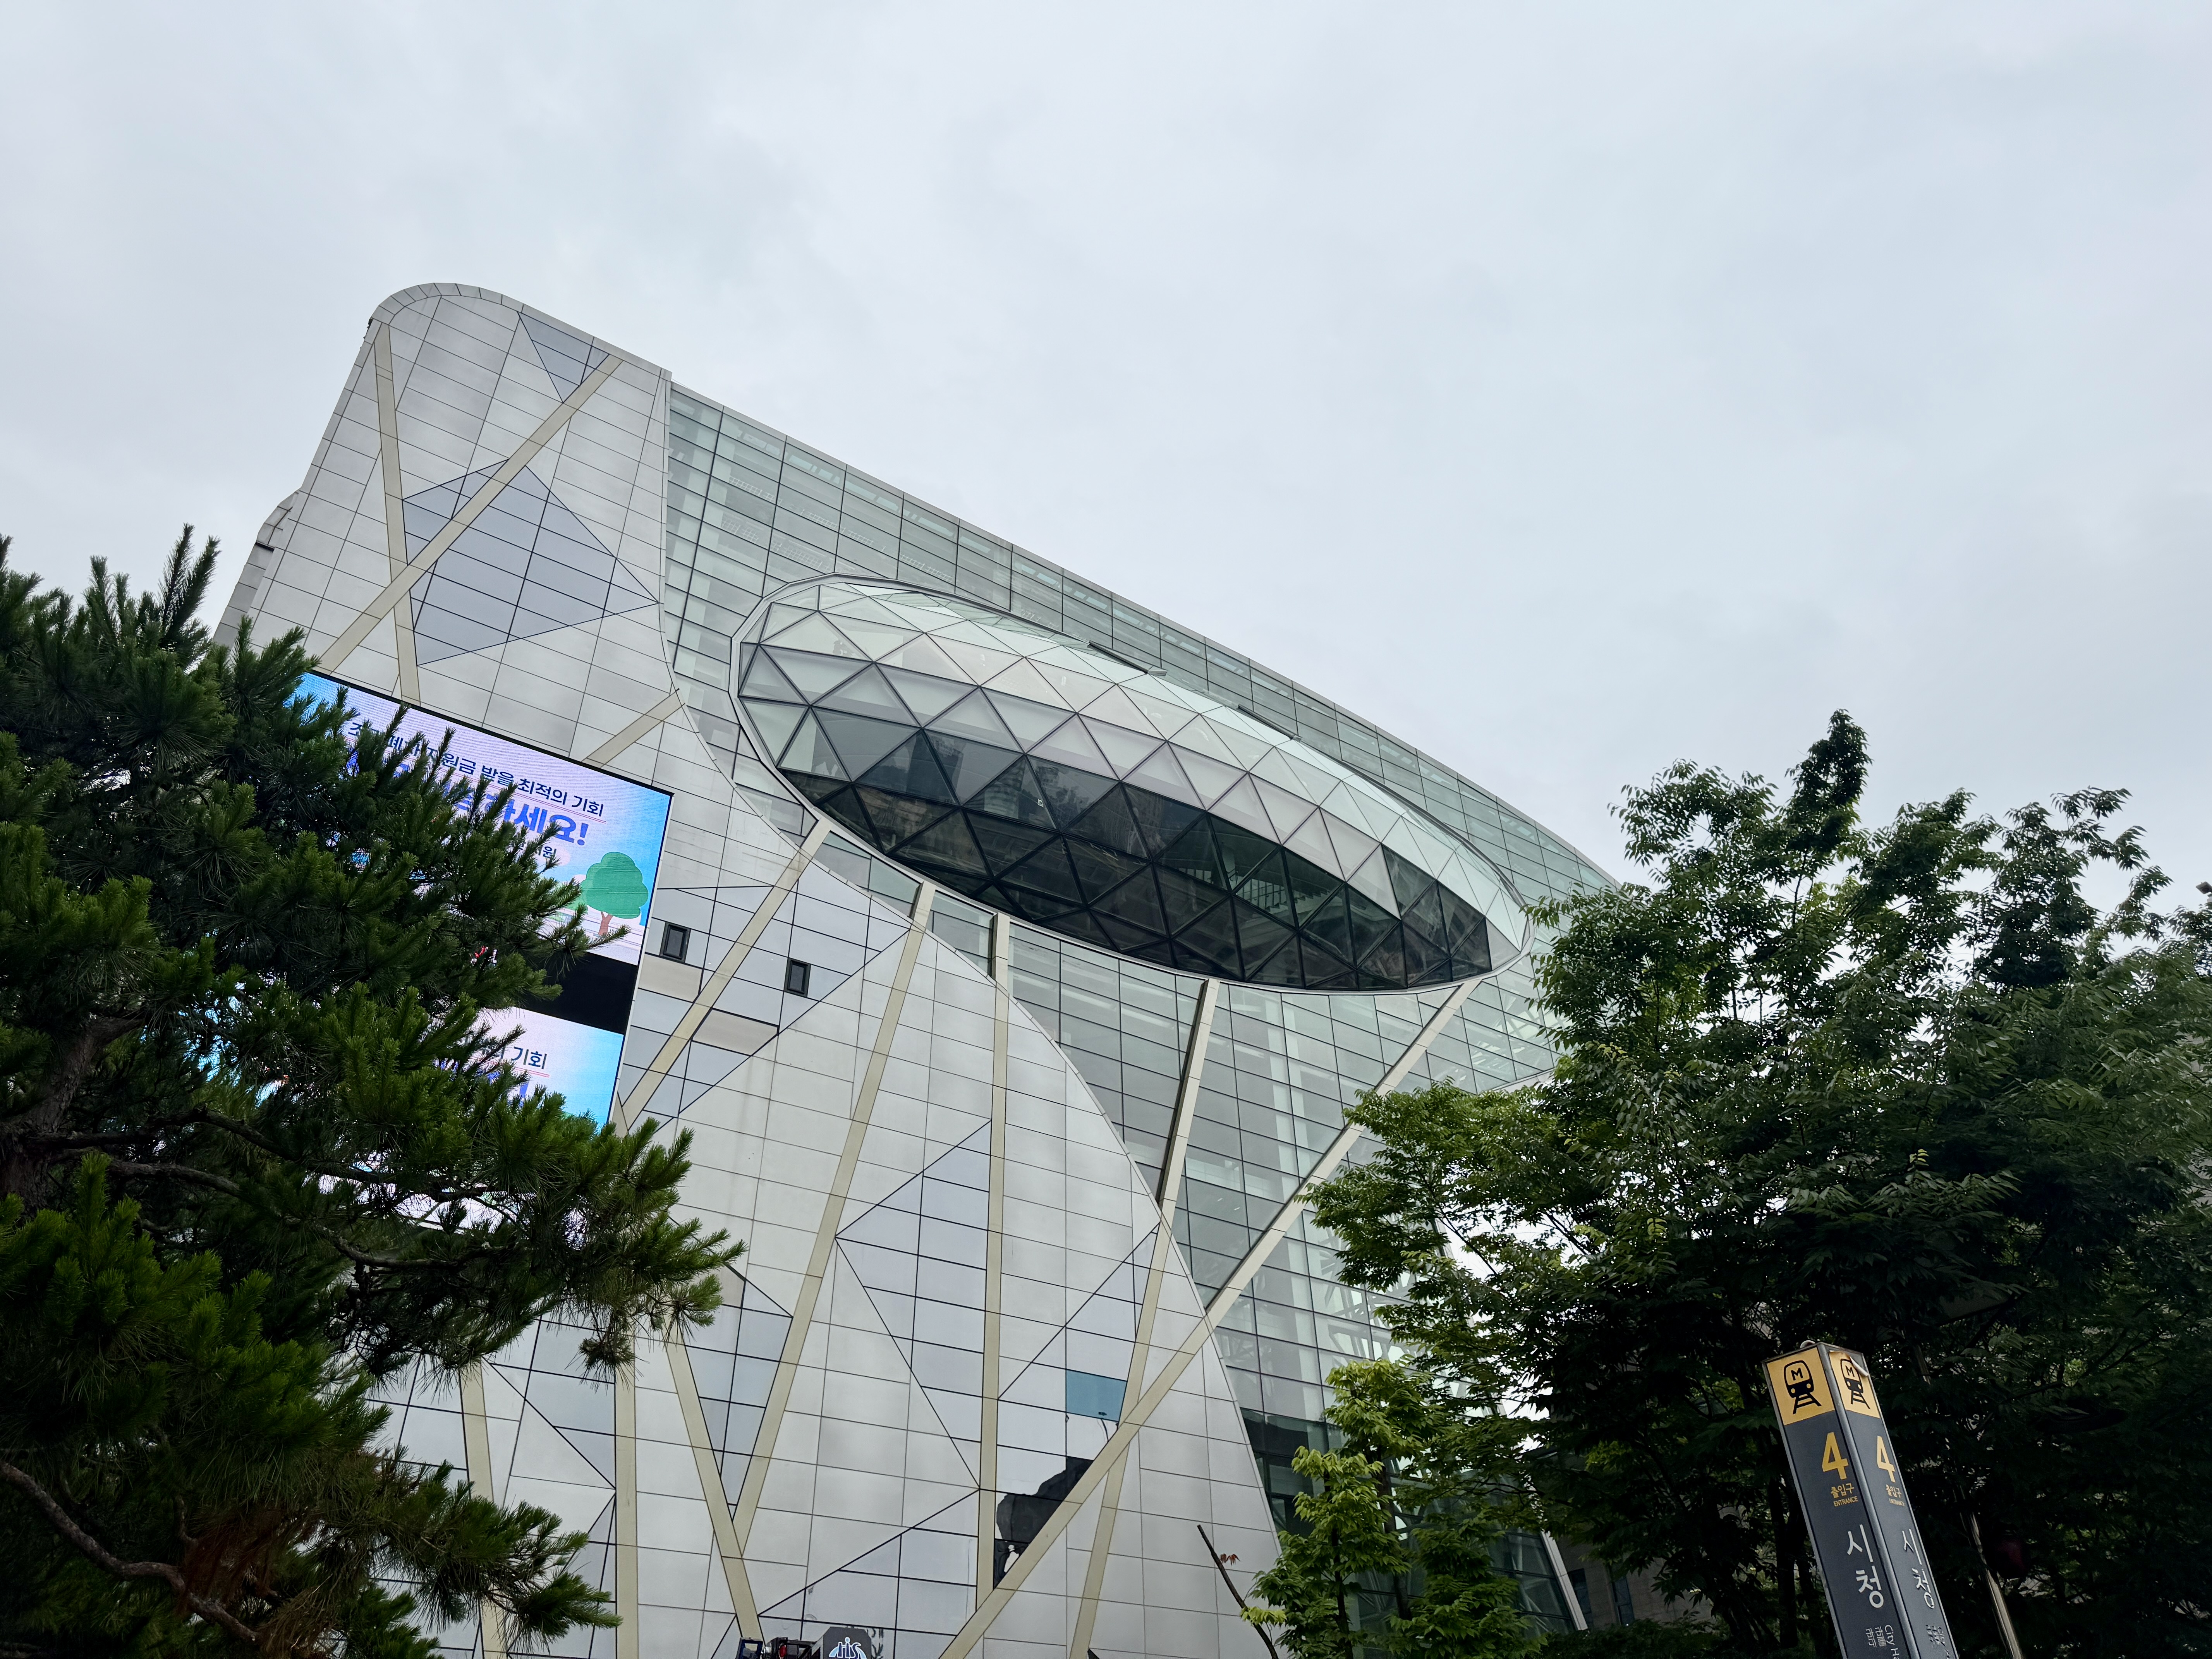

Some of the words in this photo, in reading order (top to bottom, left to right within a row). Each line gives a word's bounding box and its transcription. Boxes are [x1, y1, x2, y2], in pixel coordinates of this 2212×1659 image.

[518, 778, 567, 805] 최적의
[572, 795, 604, 817] 기회
[511, 1046, 547, 1069] 기회
[1791, 1367, 1803, 1381] M
[1845, 1365, 1855, 1377] M
[1822, 1432, 1849, 1480] 4
[1877, 1436, 1896, 1482] 4
[1831, 1483, 1854, 1498] 출입구
[1886, 1484, 1901, 1498] 출입구
[1833, 1496, 1858, 1507] ENTRANCE
[1847, 1524, 1884, 1608] 시청
[1901, 1528, 1934, 1609] 시청
[1885, 1625, 1895, 1645] City
